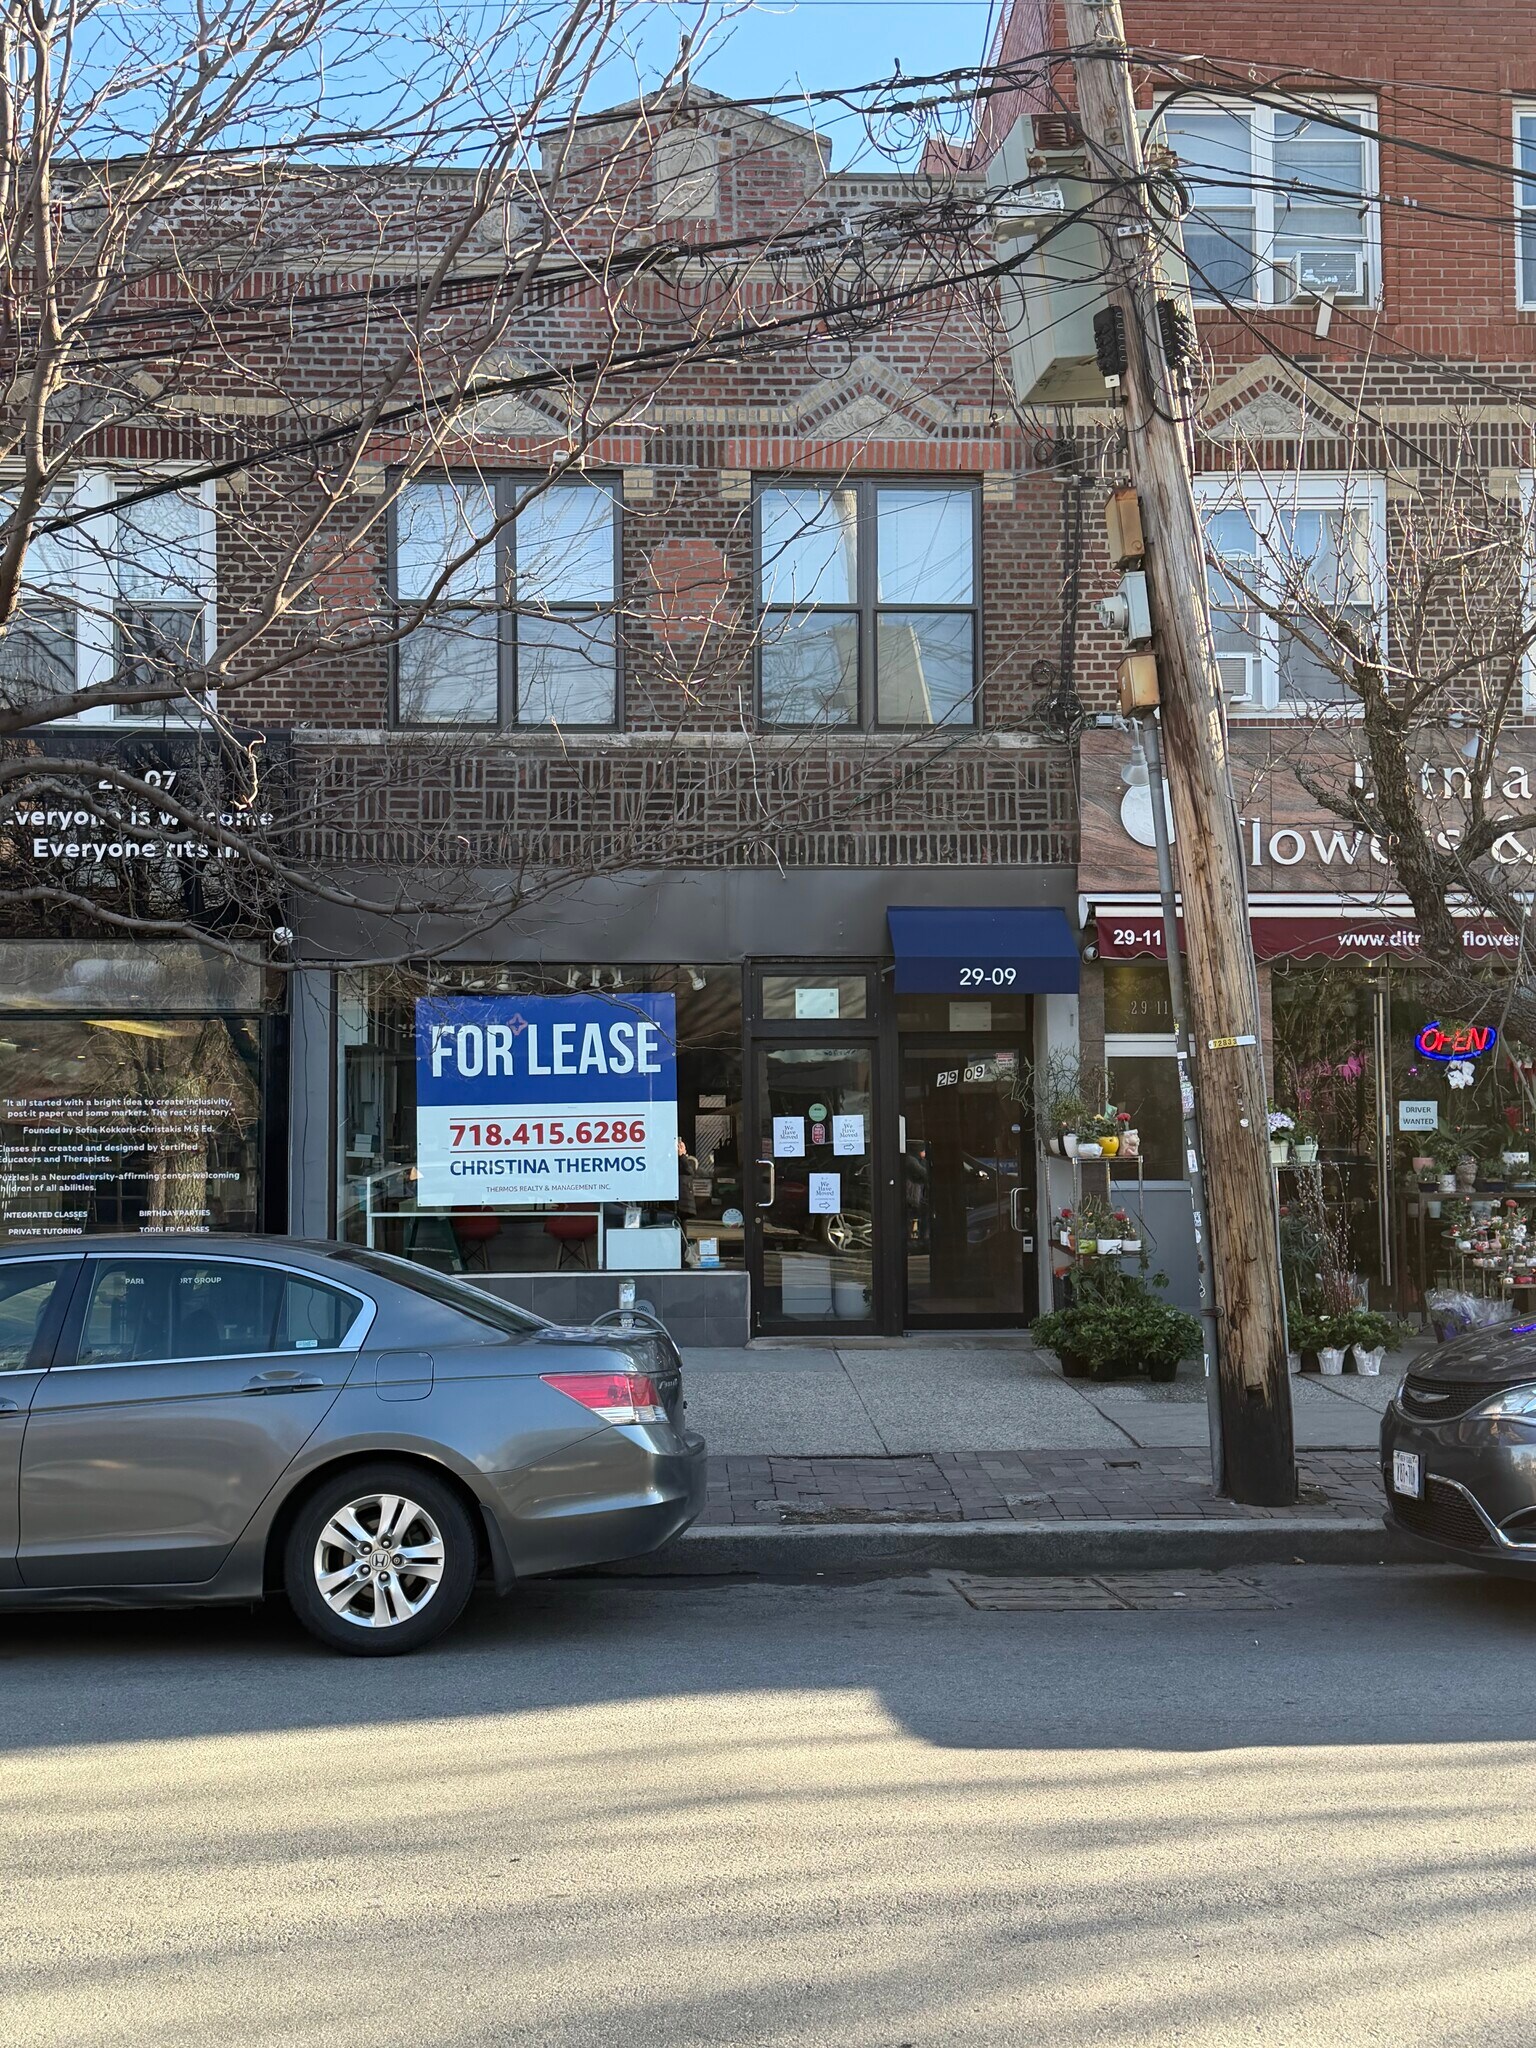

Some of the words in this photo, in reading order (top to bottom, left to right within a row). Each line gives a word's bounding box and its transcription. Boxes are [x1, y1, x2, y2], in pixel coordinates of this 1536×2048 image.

[131, 805, 150, 826] is
[33, 838, 156, 862] Everyone
[1113, 929, 1161, 945] 29-11
[959, 967, 1017, 986] 29-09
[1130, 1000, 1148, 1015] 29
[1156, 1000, 1168, 1015] 11
[432, 1022, 514, 1077] FOR
[527, 1021, 662, 1076] LEASE
[938, 1071, 958, 1086] 29
[964, 1065, 985, 1081] 09
[16, 1098, 27, 1107] all
[29, 1098, 62, 1107] started
[64, 1098, 84, 1106] with
[94, 1098, 121, 1108] bright
[123, 1097, 142, 1106] idea
[144, 1098, 154, 1106] to
[156, 1098, 187, 1106] create
[186, 1097, 233, 1107] inclusivity,
[39, 1110, 65, 1118] paper
[67, 1108, 83, 1117] and
[86, 1109, 109, 1117] some
[111, 1108, 149, 1117] markers.
[151, 1108, 168, 1117] The
[169, 1108, 187, 1116] rest
[189, 1108, 197, 1116] is
[1402, 1117, 1435, 1125] WANTED
[23, 1126, 61, 1134] Founded
[62, 1126, 73, 1135] by
[75, 1126, 97, 1134] Sofia
[99, 1125, 182, 1133] Kokkoris-Christakis
[201, 1125, 214, 1133] Ed.
[449, 1119, 646, 1147] 718.415.6286
[49, 1144, 83, 1152] created
[85, 1144, 102, 1152] and
[104, 1143, 145, 1153] designed
[147, 1143, 158, 1153] by
[160, 1143, 198, 1151] certified
[43, 1155, 61, 1163] and
[63, 1155, 112, 1164] Therapists.
[449, 1157, 550, 1177] CHRISTINA
[554, 1156, 646, 1174] THERMOS
[0, 1173, 32, 1181] uzzles
[32, 1173, 39, 1181] is
[49, 1172, 160, 1182] Neurodiversity-affirming
[193, 1171, 240, 1181] welcoming
[34, 1184, 44, 1192] of
[46, 1184, 56, 1192] all
[59, 1183, 96, 1192] abilities.
[598, 1183, 612, 1191] INC.
[5, 1211, 53, 1219] INTEGRATED
[54, 1211, 88, 1219] CLASSES
[8, 1228, 41, 1236] PRIVATE
[43, 1227, 83, 1235] TUTORING
[194, 1276, 222, 1284] GROUP
